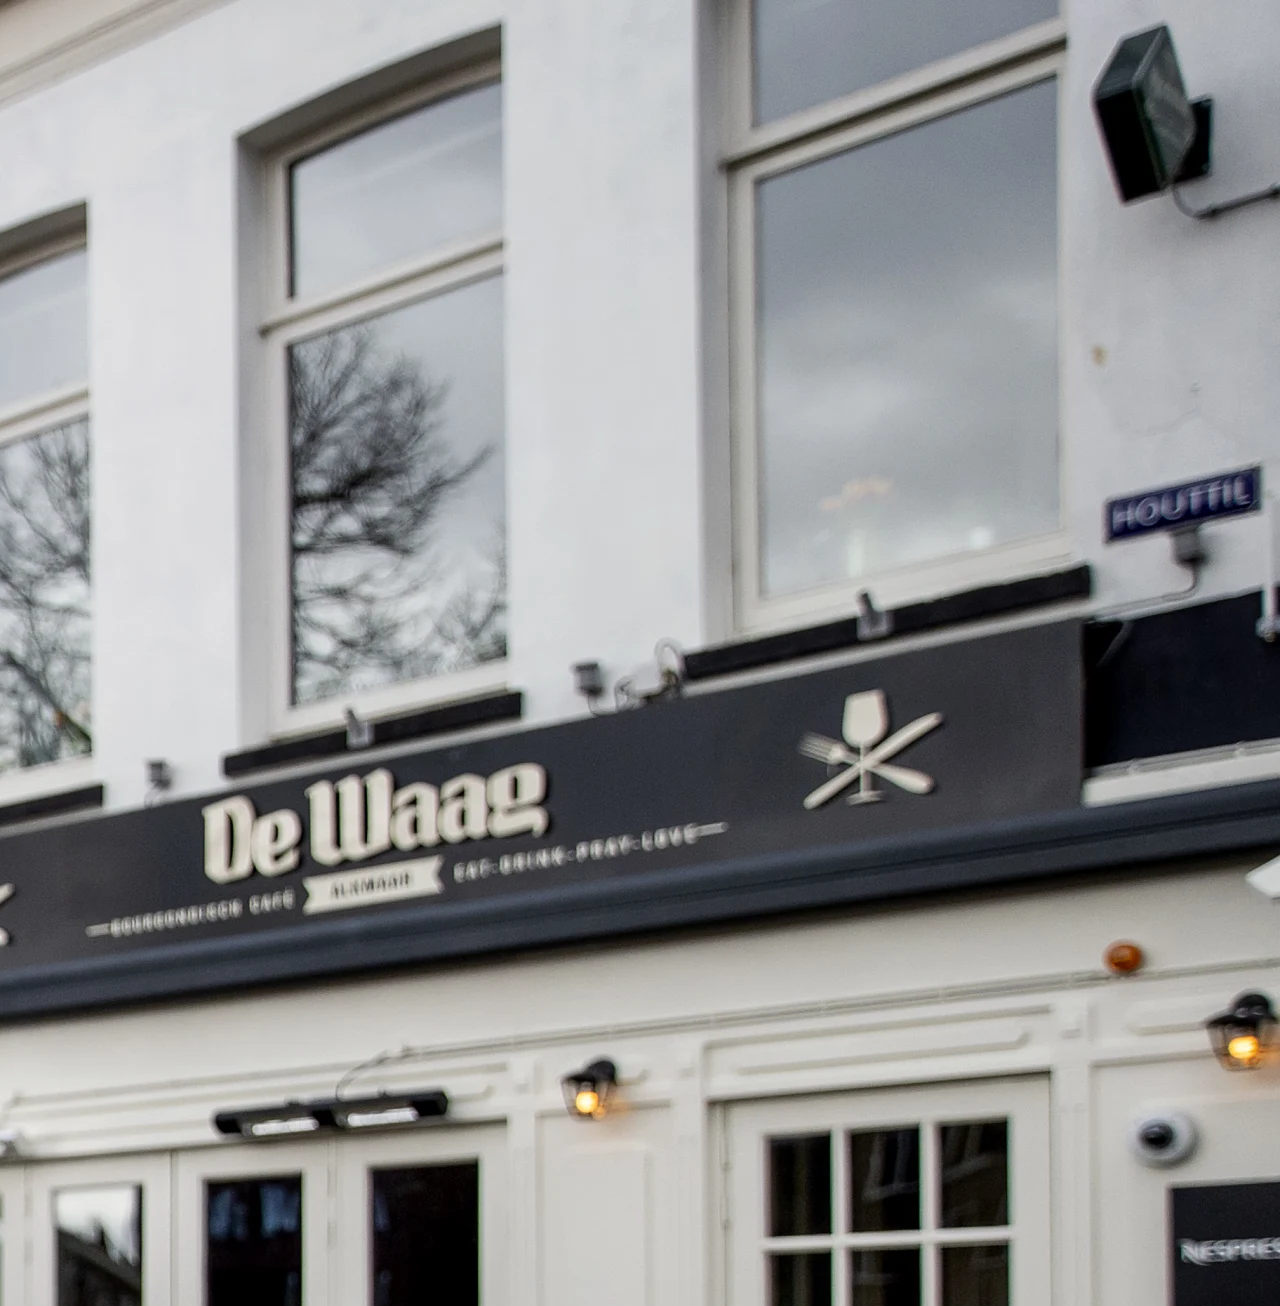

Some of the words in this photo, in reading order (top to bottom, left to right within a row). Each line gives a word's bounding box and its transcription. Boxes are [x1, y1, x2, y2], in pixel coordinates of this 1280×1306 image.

[1112, 475, 1250, 533] HOUTTIL
[202, 795, 301, 884] De
[305, 762, 549, 866] Waag
[249, 885, 296, 915] CAFÉ
[330, 871, 410, 898] ALKMAAR
